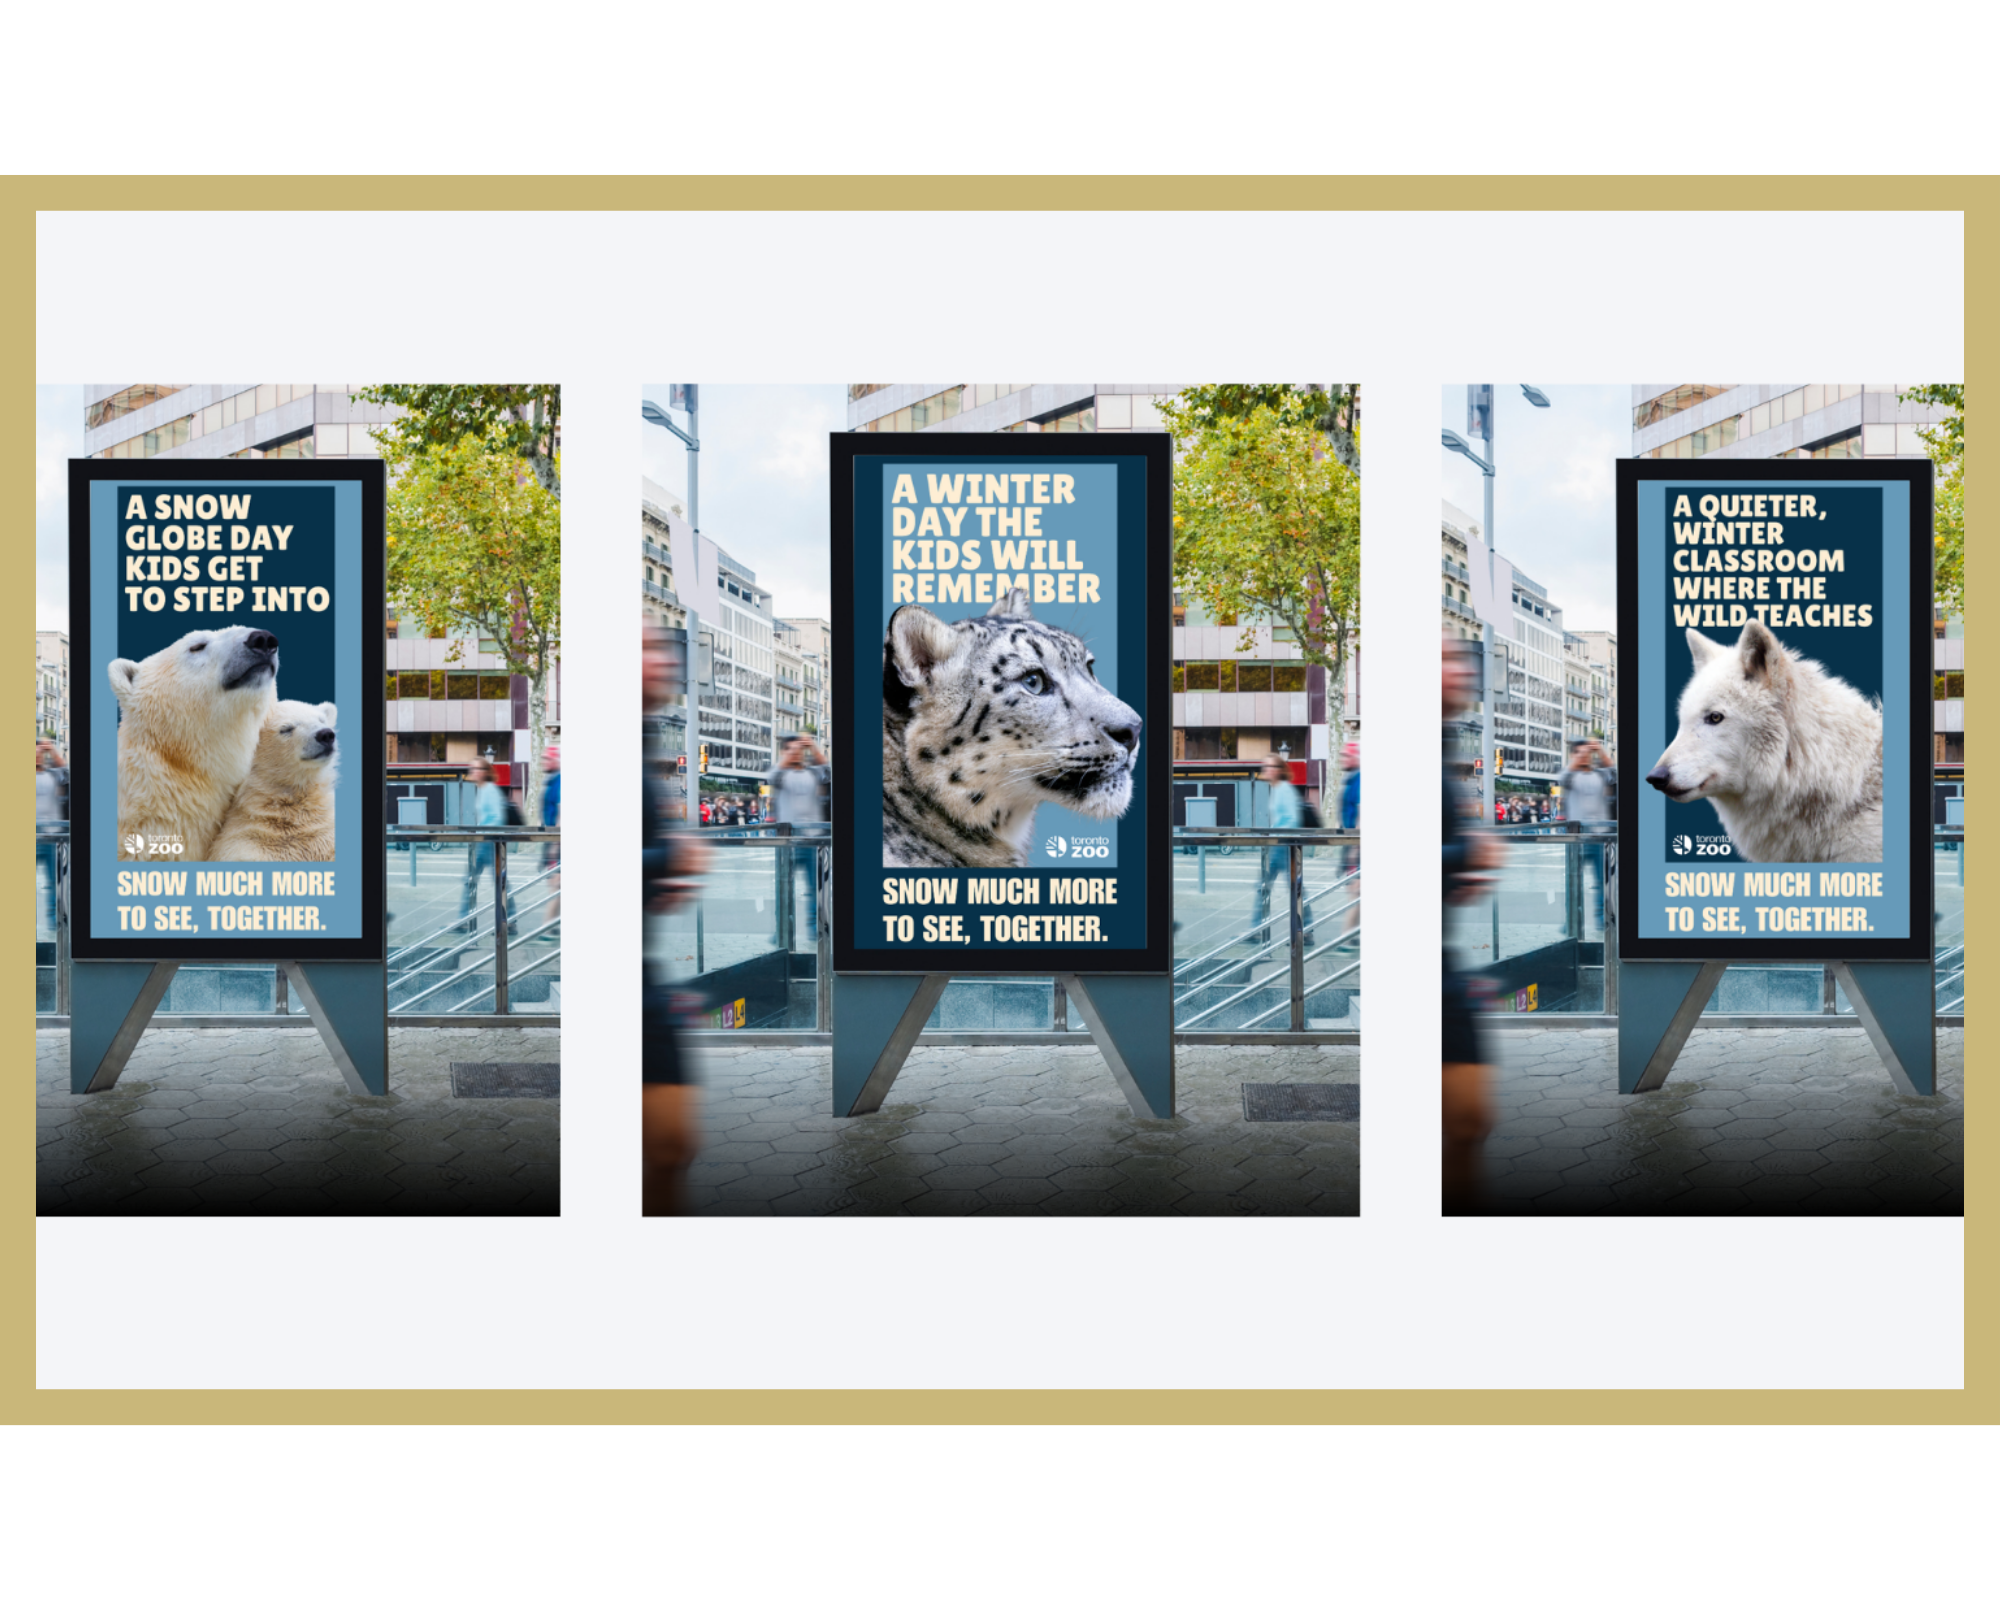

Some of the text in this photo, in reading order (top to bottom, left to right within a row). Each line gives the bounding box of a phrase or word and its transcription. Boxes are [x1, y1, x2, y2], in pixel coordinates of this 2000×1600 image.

[891, 474, 1076, 504] A WINTER
[125, 494, 251, 521] A SNOW
[1673, 494, 1827, 522] A QUIETER,
[893, 507, 1042, 537] DAY THE
[1673, 521, 1785, 545] WINTER
[126, 525, 294, 551] GLOBE DAY
[893, 539, 1084, 570] KIDS WILL
[1673, 549, 1845, 573] CLASSROOM
[126, 556, 263, 581] KIDS GET
[125, 586, 330, 612] TO STEP INTO
[893, 573, 1101, 603] REMEMBER
[1673, 577, 1827, 600] WHERE THE
[1673, 604, 1874, 628] WILD TEACHES
[147, 834, 184, 842] toronto
[1071, 836, 1109, 845] toronto
[1695, 835, 1731, 843] toronto
[117, 871, 335, 896] SNOW MUCH MORE
[882, 878, 1118, 906] SNOW MUCH MORE
[1664, 872, 1884, 897] SNOW MUCH MORE
[117, 905, 326, 933] TO SEE, TOGETHER.
[883, 915, 1109, 945] TO SEE, TOGETHER.
[1665, 906, 1875, 934] TO SEE, TOGETHER.
[1516, 994, 1527, 1012] L2
[1528, 989, 1538, 1005] L4
[722, 1009, 733, 1028] L2
[735, 1004, 745, 1021] L4
